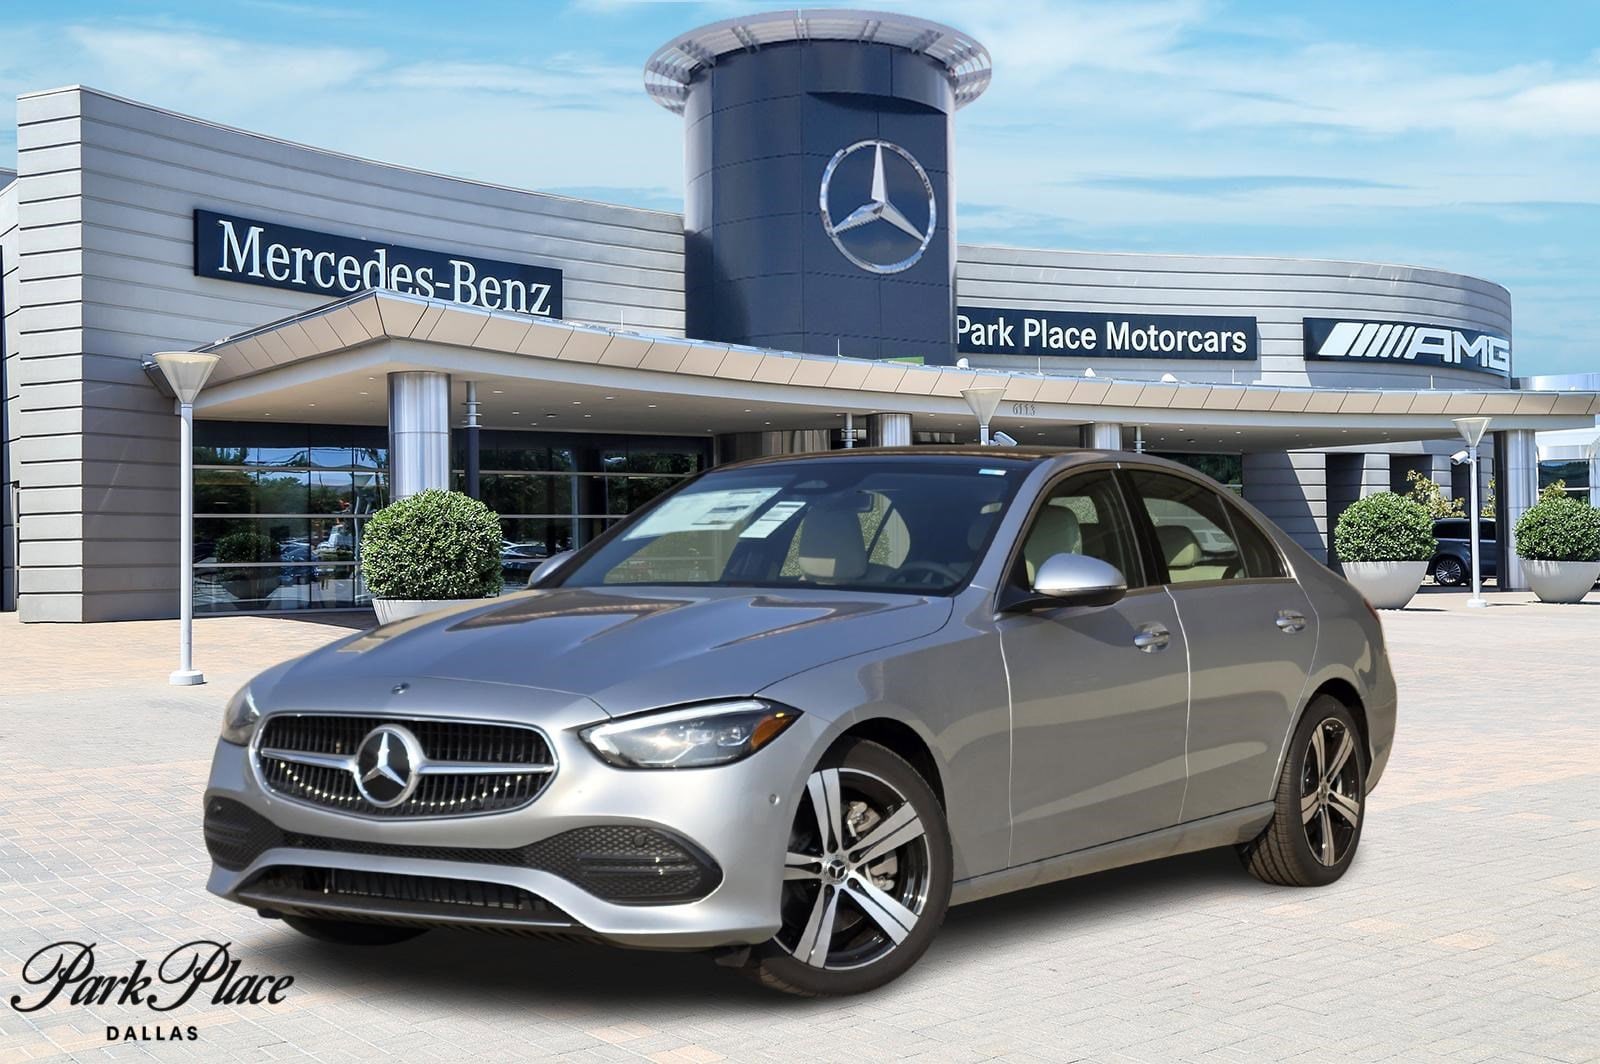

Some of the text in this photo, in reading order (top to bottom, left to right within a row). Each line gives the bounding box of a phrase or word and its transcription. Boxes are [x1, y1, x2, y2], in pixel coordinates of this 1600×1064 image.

[218, 220, 551, 316] Mercedes-Benz
[957, 315, 1248, 352] Park Place Motorcars
[1404, 327, 1510, 373] AMG
[1013, 403, 1036, 416] 6113
